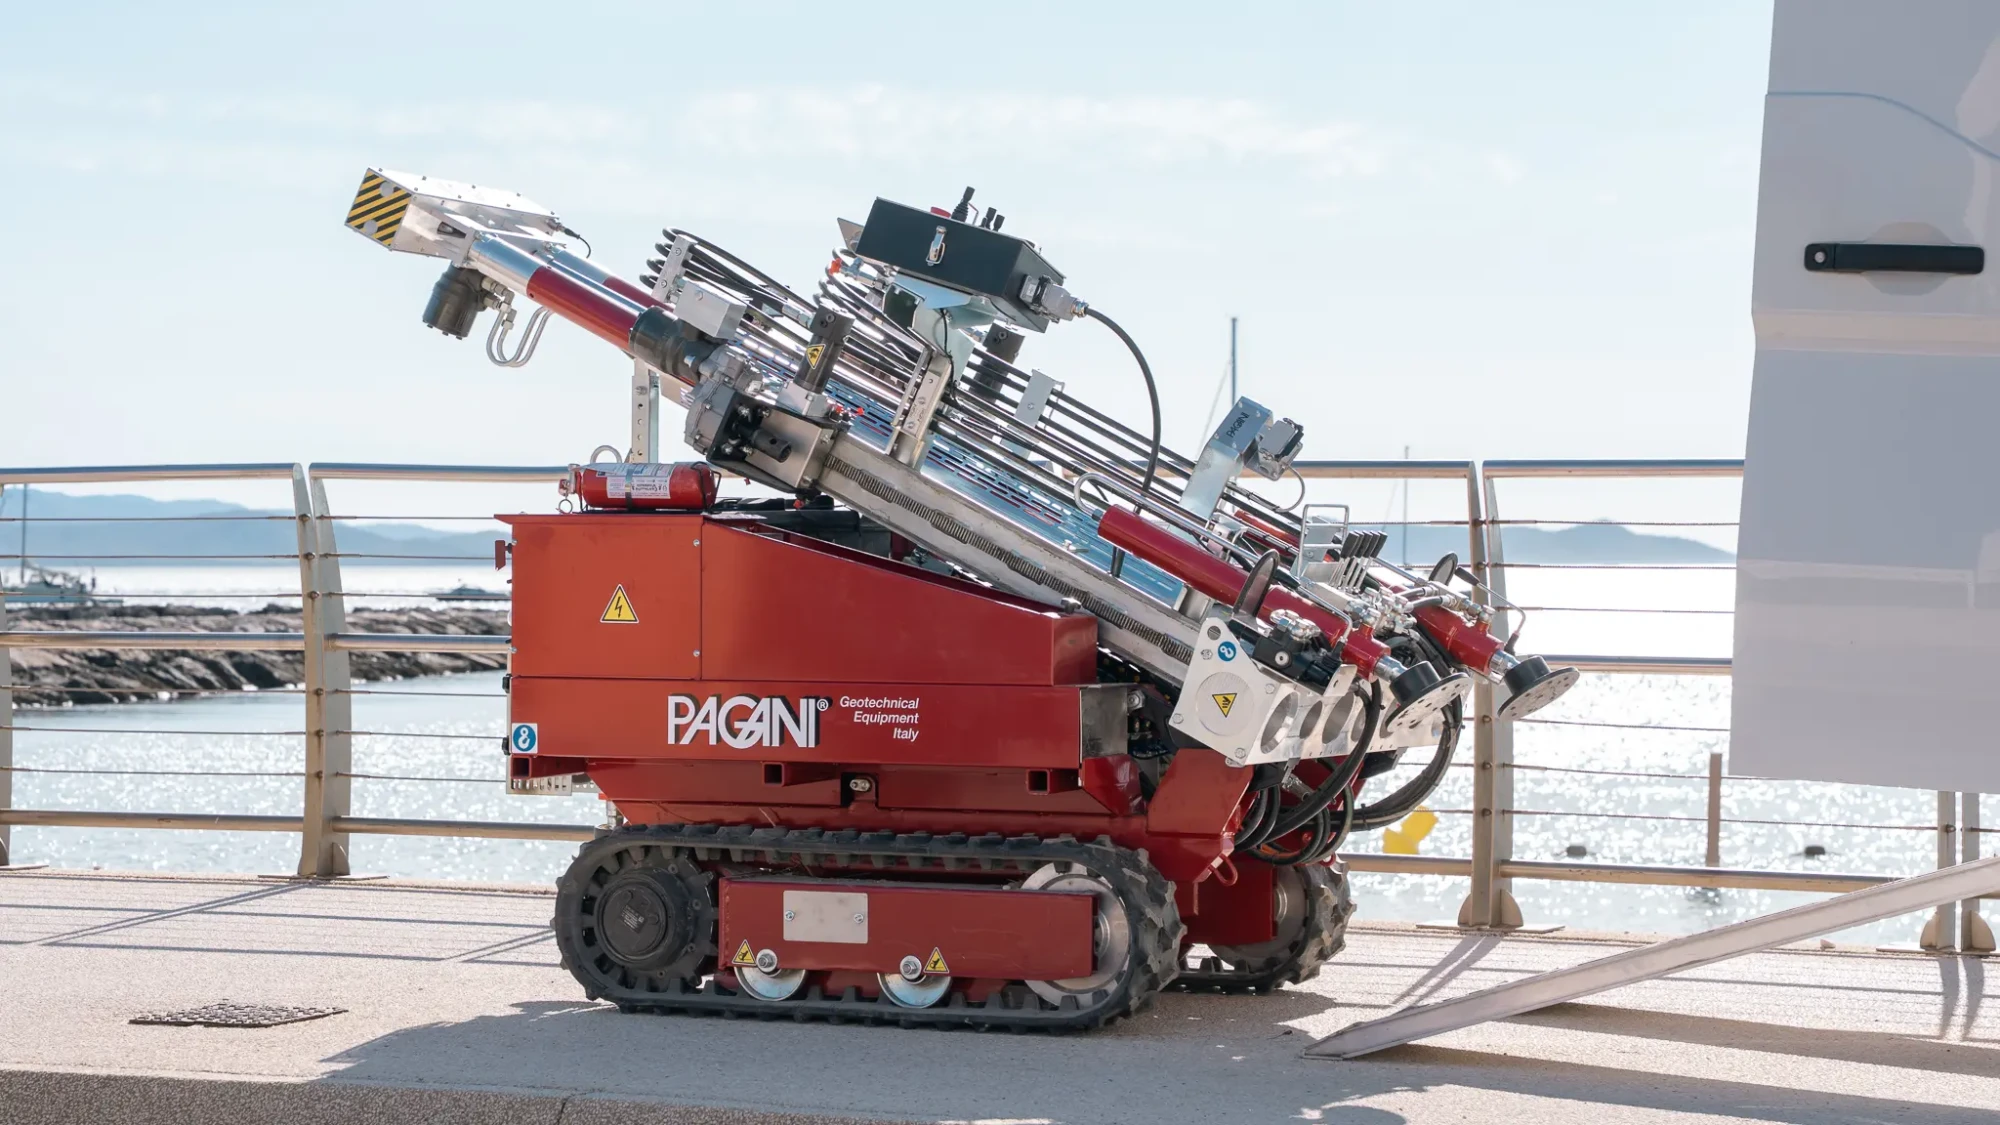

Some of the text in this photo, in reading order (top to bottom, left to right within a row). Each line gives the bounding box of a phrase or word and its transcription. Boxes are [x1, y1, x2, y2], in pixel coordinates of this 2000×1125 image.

[1226, 412, 1250, 438] PAGANI
[839, 695, 920, 709] Geotechnical
[853, 710, 920, 726] Equipment
[892, 727, 919, 742] Italy
